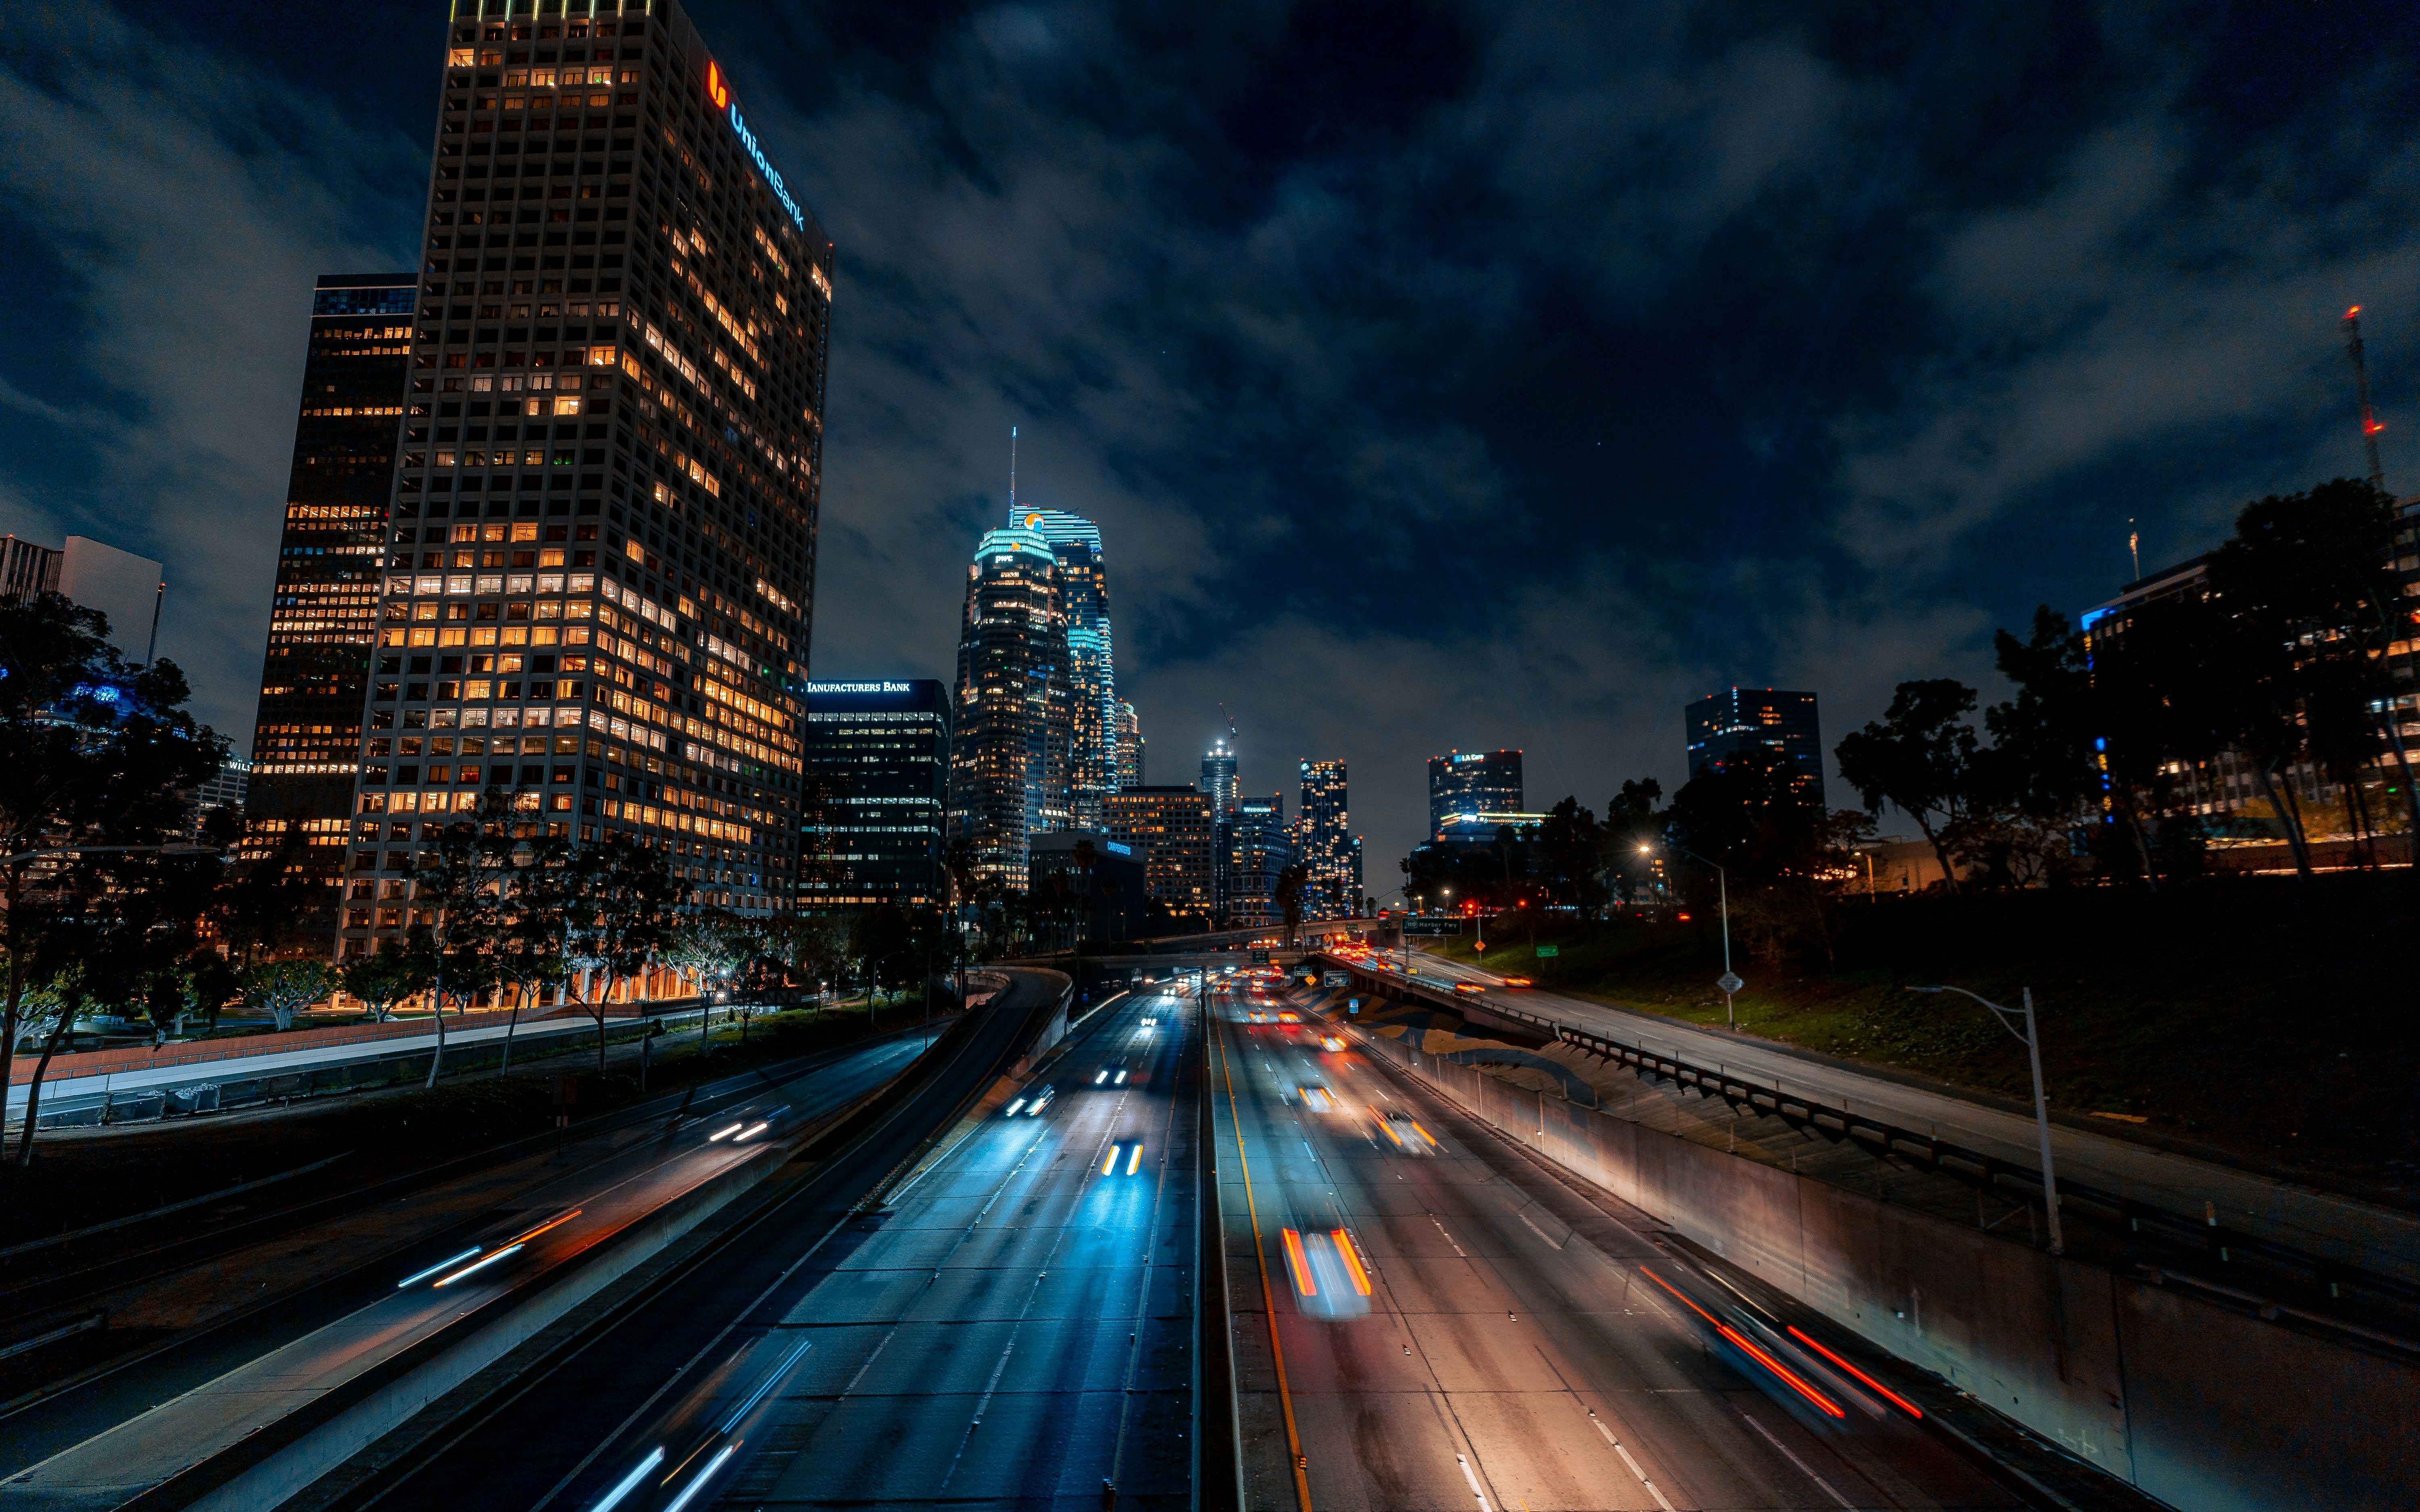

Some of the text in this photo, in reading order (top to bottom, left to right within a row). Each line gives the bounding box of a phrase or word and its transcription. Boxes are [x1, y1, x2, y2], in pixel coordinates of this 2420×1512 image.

[731, 102, 803, 231] UnionBank
[995, 555, 1013, 563] pwc
[883, 681, 910, 692] BANK
[1107, 841, 1131, 856] CARPENTERS
